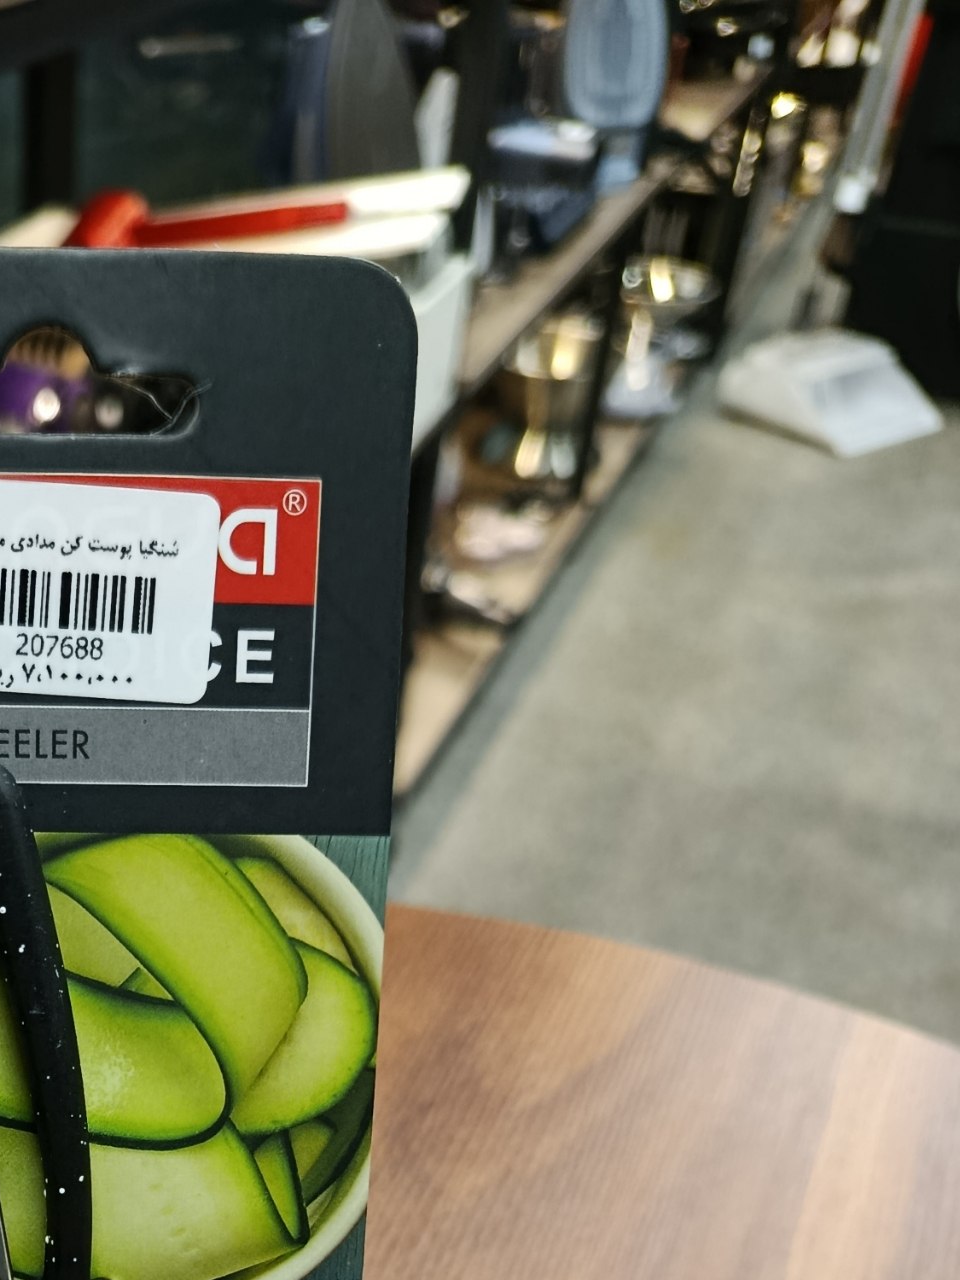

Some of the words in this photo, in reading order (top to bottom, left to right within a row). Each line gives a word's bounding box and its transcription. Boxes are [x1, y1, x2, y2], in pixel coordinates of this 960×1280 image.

[10, 533, 56, 553] مدادی
[60, 535, 84, 556] کن
[87, 539, 132, 560] پوست
[15, 632, 104, 661] 207688
